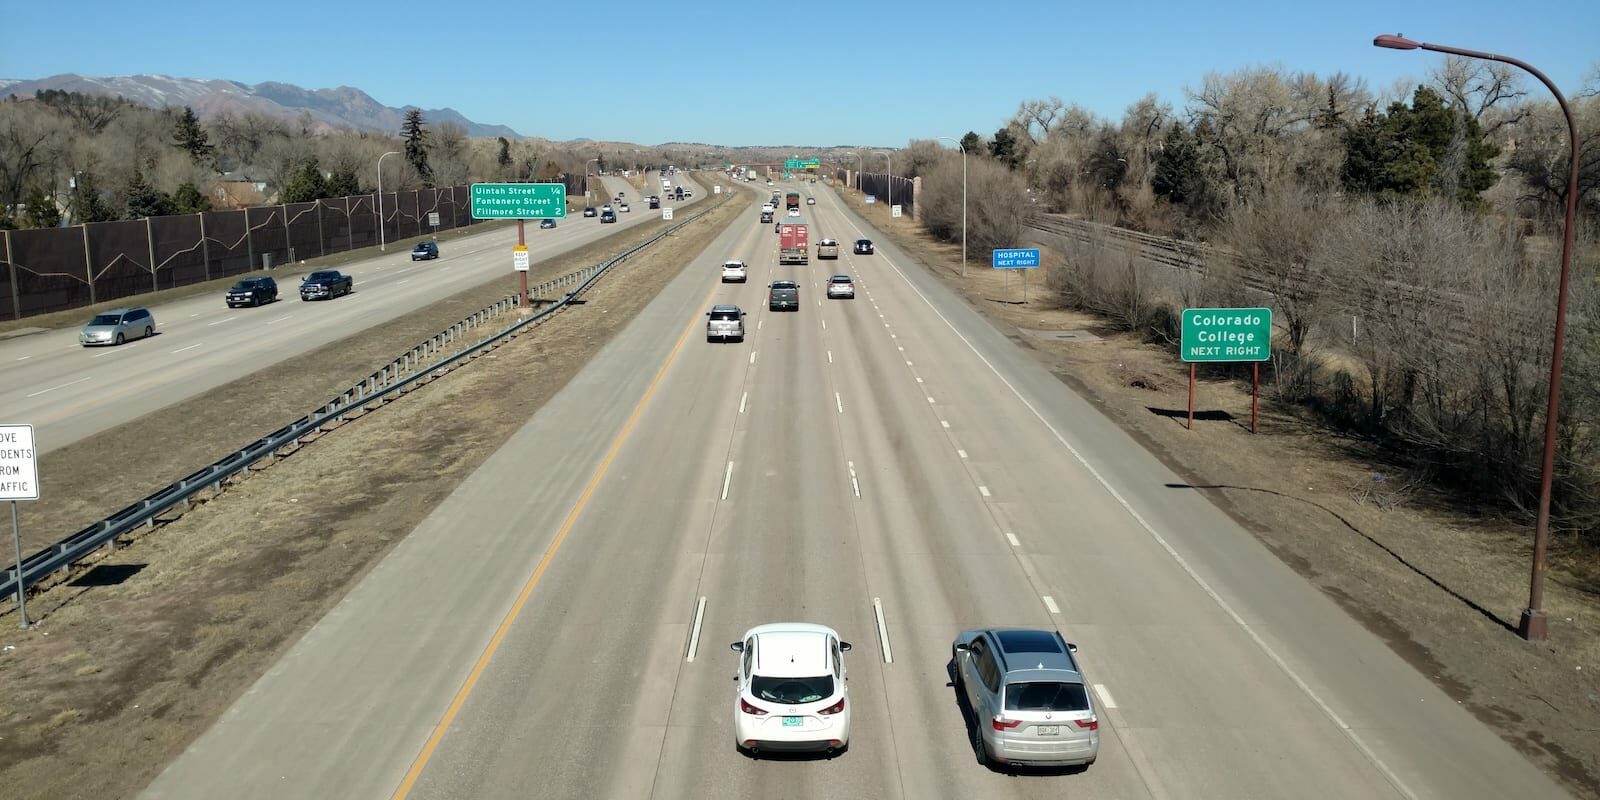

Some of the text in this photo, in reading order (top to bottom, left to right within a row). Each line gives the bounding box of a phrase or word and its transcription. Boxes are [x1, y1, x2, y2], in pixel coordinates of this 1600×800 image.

[1193, 315, 1260, 326] Colorado
[1198, 331, 1254, 345] College
[1191, 347, 1260, 356] NEXT RIGHT
[1, 449, 32, 459] DENTS
[0, 466, 20, 475] ROM
[0, 482, 28, 492] AFFIC
